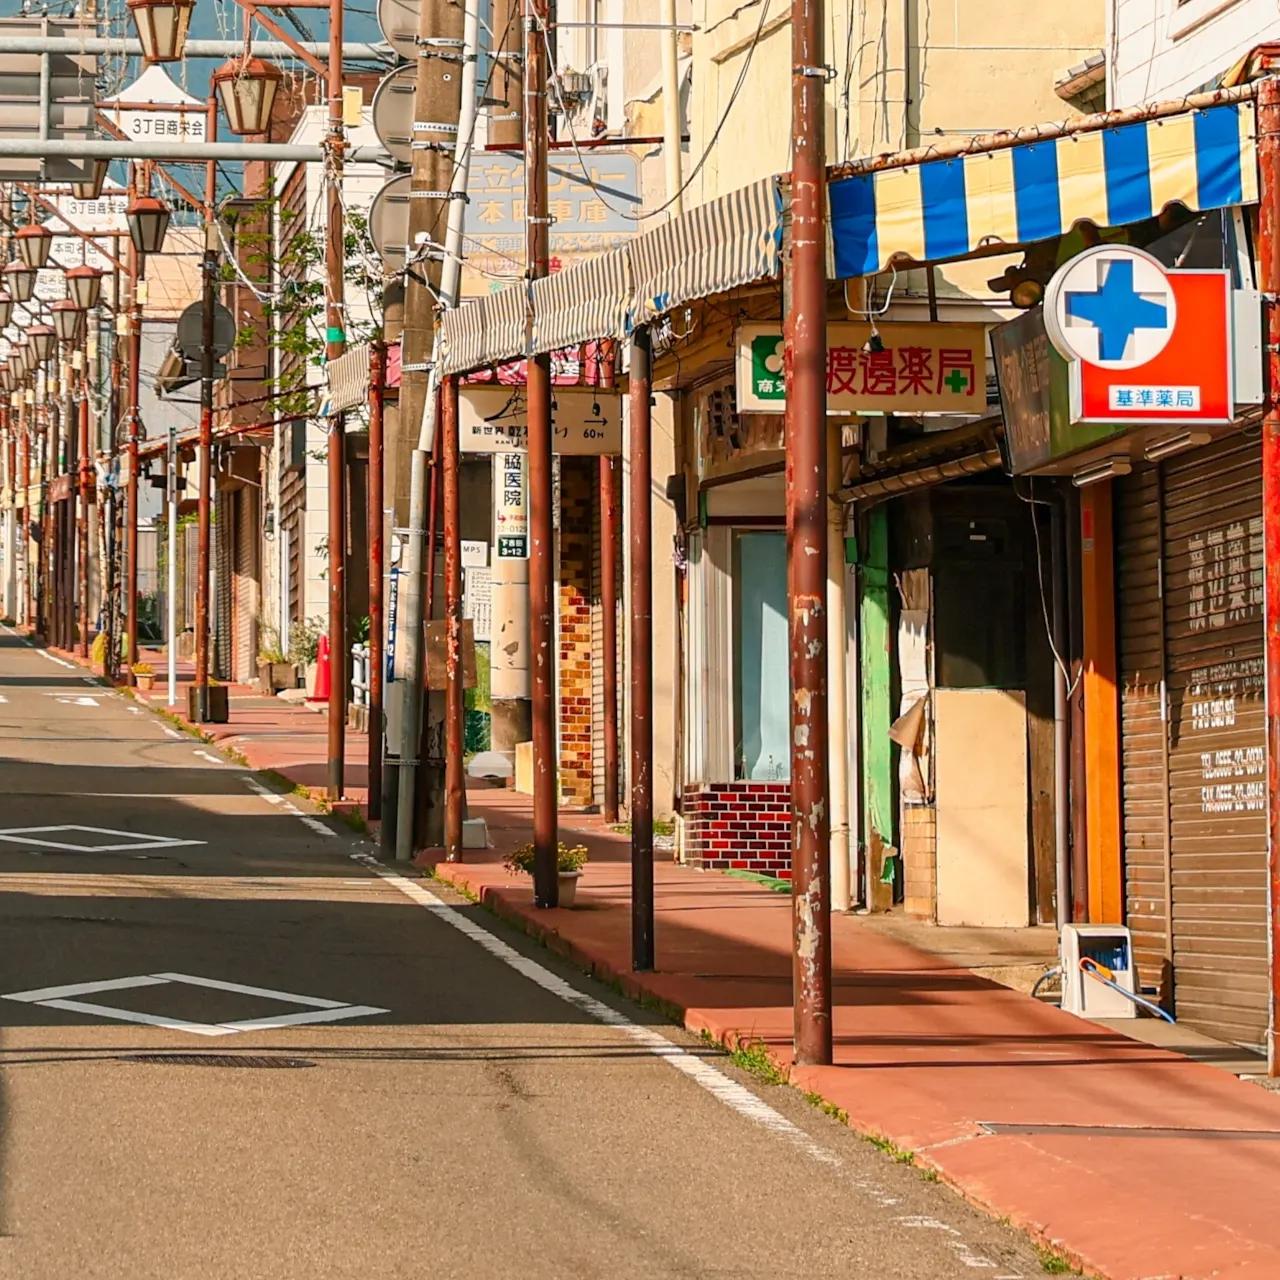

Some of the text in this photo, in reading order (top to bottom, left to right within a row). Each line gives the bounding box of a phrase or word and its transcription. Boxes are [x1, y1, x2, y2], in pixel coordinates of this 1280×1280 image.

[132, 119, 203, 136] 3丁目商栄会
[1116, 389, 1194, 408] 基準薬局
